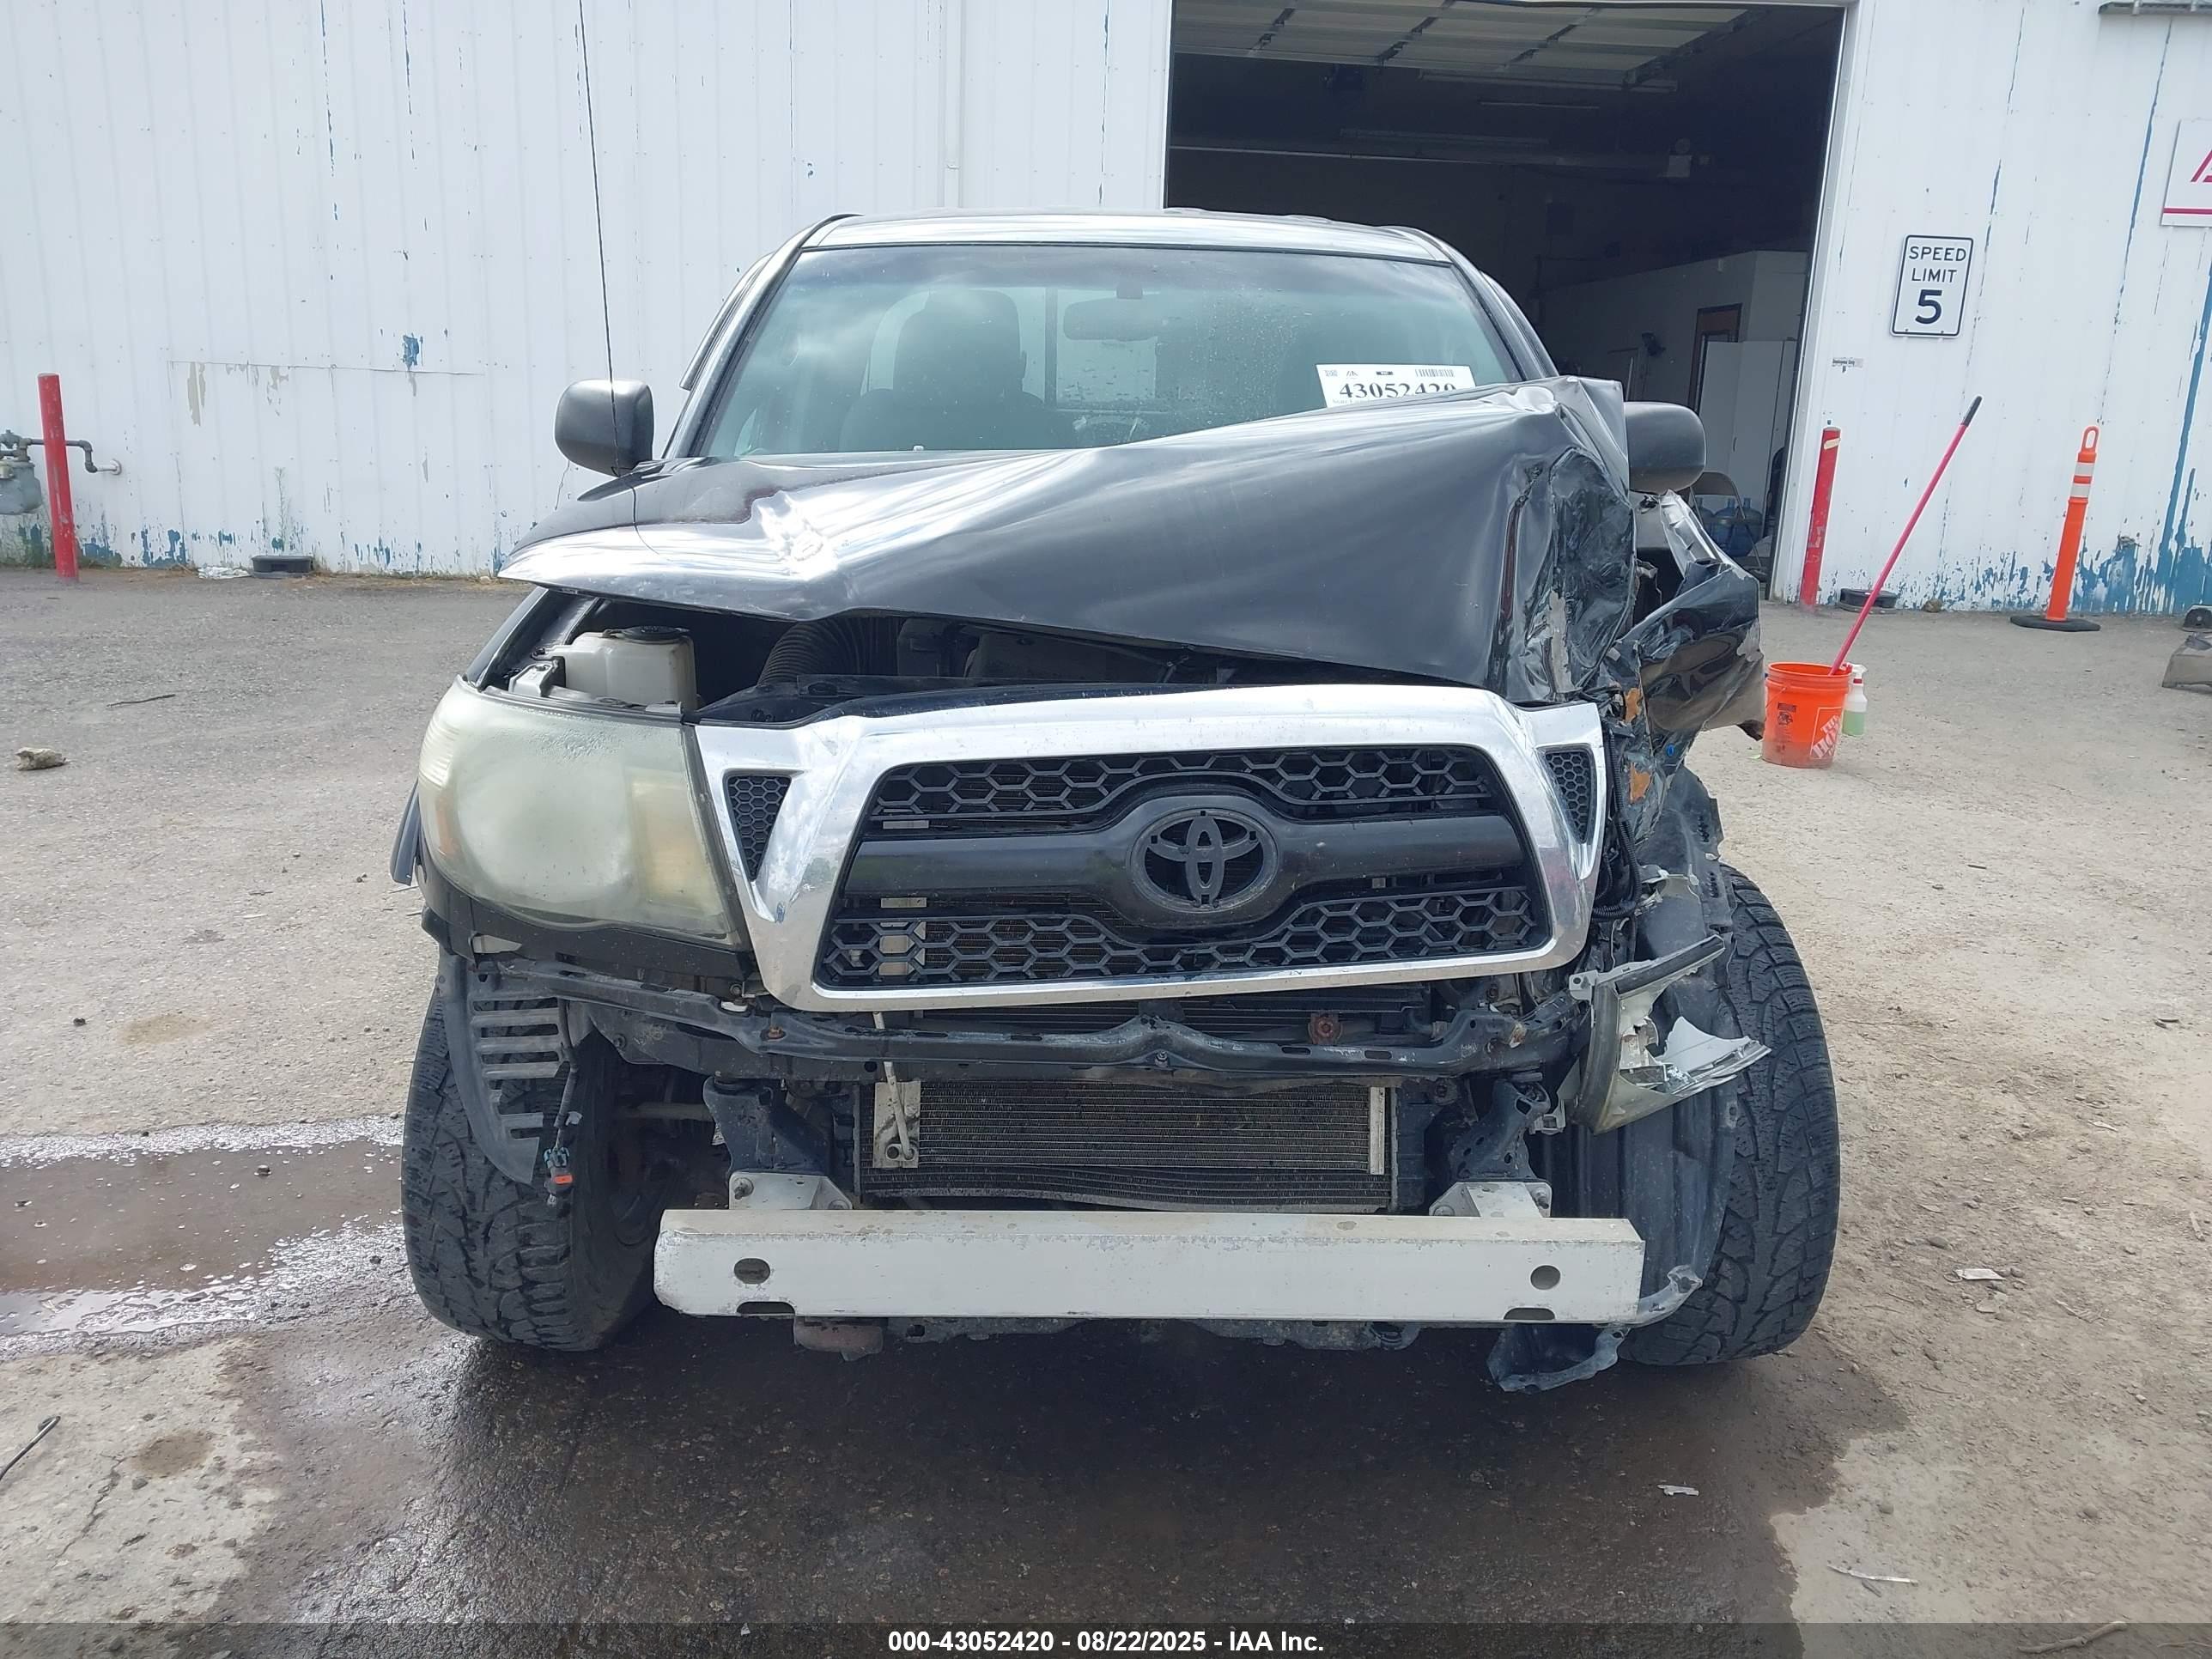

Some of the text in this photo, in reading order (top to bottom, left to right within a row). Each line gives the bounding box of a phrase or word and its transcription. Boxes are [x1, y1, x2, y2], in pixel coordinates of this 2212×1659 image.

[1909, 246, 1966, 262] SPEED
[1911, 268, 1957, 283] LIMIT
[1915, 289, 1942, 325] 5
